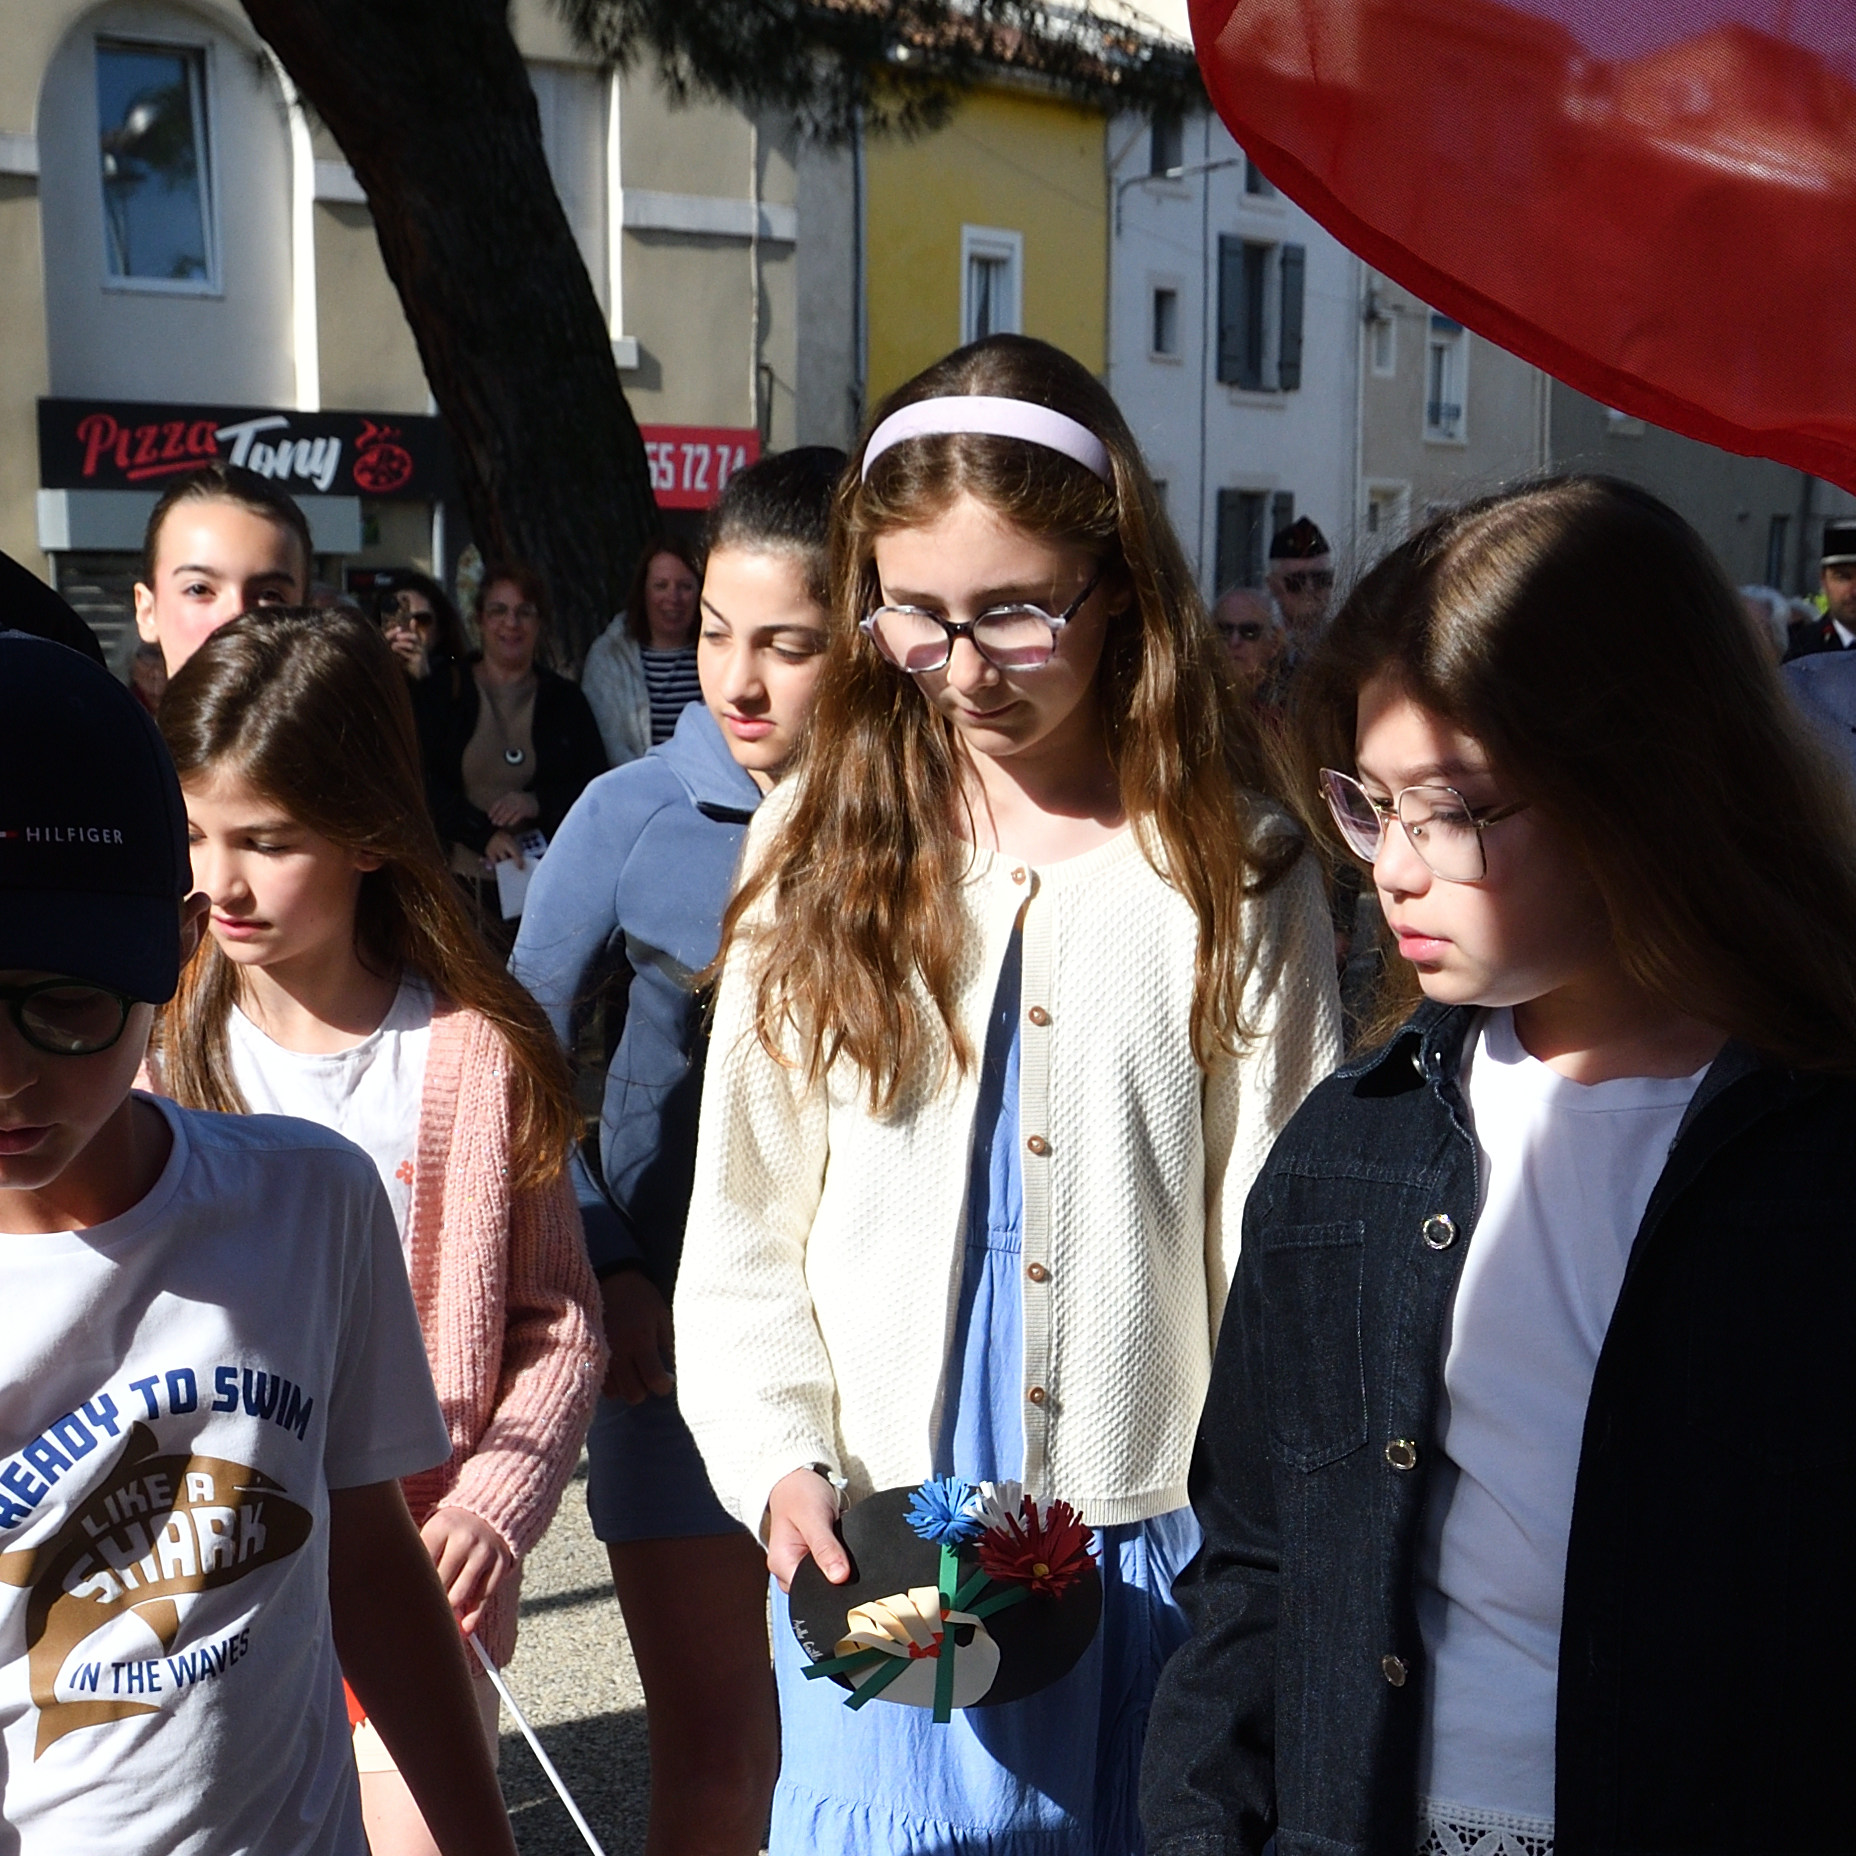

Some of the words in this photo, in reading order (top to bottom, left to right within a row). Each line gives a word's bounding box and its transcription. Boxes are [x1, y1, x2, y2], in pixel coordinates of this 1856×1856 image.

[76, 413, 220, 481] Pizza
[214, 415, 342, 492] Tony
[680, 442, 712, 492] 72
[26, 826, 123, 844] HILFIGER
[129, 1368, 198, 1420] TO
[211, 1366, 314, 1441] SWIM
[80, 1472, 172, 1539] LIKE
[185, 1472, 215, 1503] A
[62, 1502, 267, 1604] SHARK
[69, 1661, 101, 1694] IN
[111, 1660, 162, 1693] THE
[166, 1627, 251, 1689] WAVES
